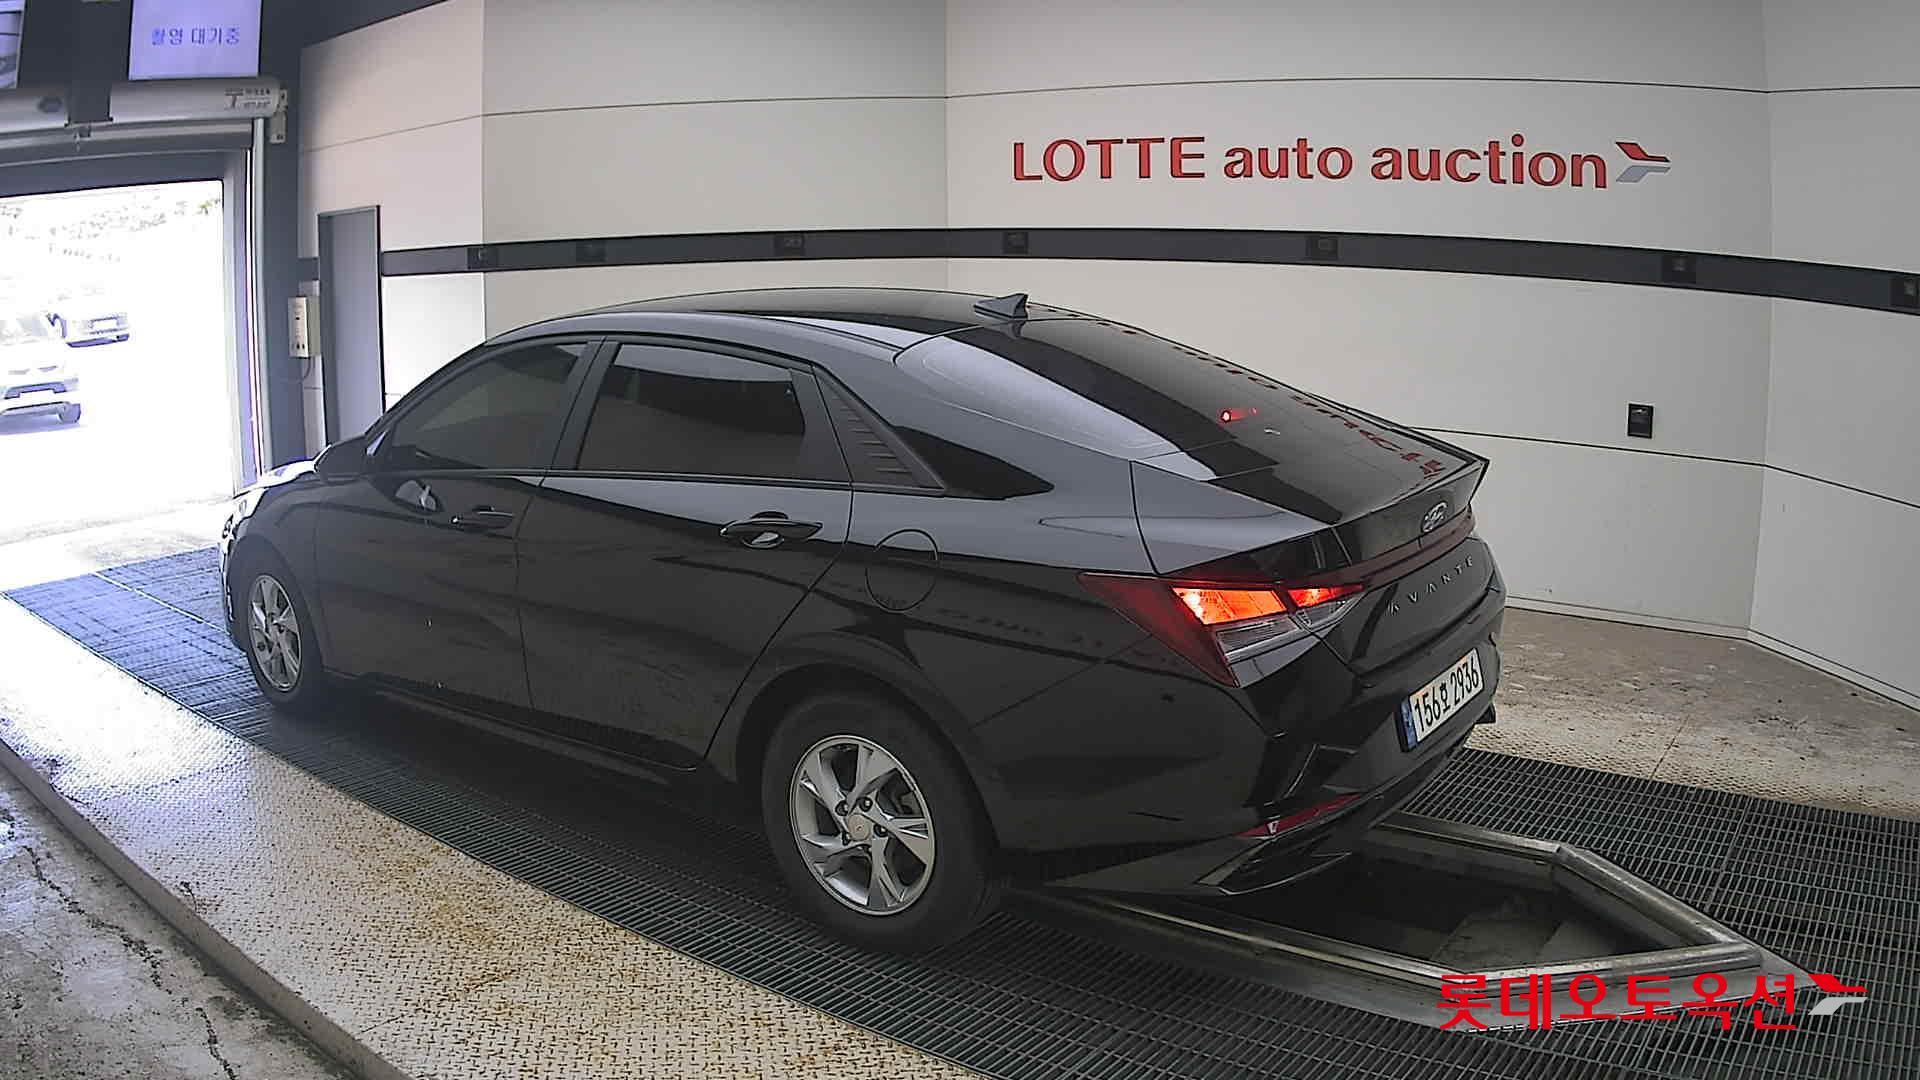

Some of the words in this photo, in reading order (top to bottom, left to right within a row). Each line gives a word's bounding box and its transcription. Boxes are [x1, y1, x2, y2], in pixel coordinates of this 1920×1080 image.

[191, 26, 241, 45] 대기중
[1013, 136, 1205, 182] LOTTE
[1224, 137, 1353, 180] auto
[1370, 133, 1607, 189] auction
[1414, 682, 1450, 732] 156호
[1450, 656, 1479, 706] 2936
